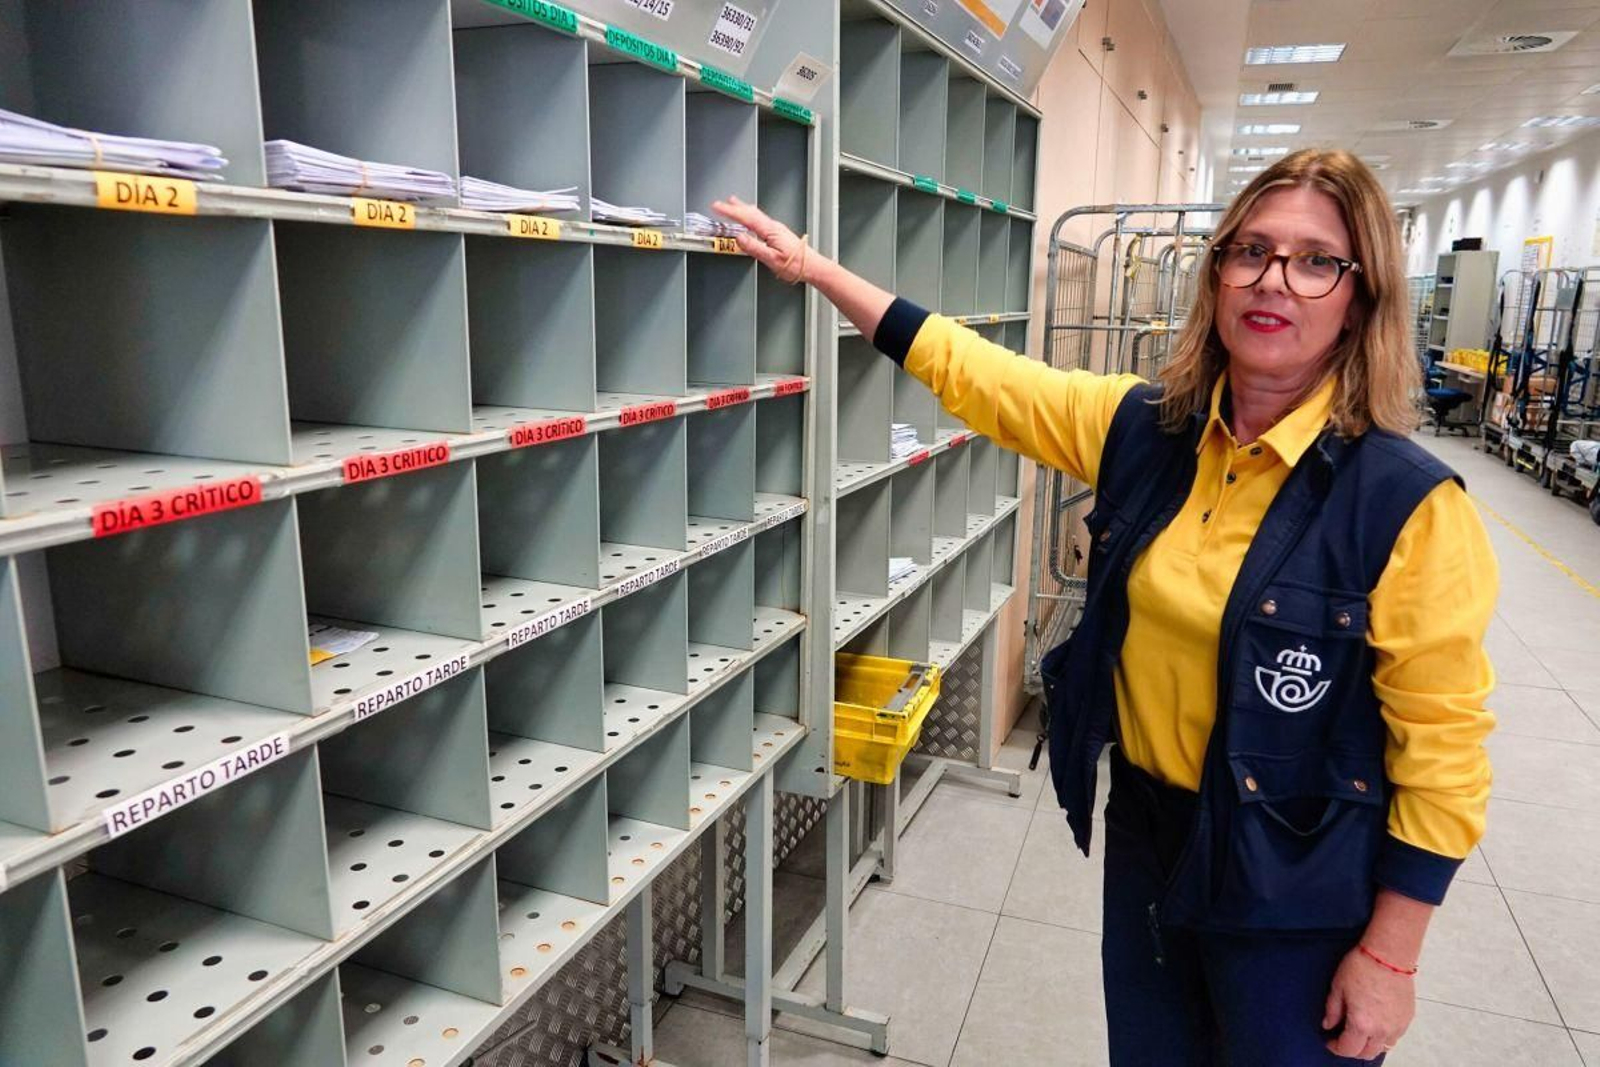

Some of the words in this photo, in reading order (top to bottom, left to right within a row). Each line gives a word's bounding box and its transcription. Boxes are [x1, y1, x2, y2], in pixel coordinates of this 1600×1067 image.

[721, 6, 755, 31] 36330/31
[711, 30, 745, 54] 36390/92
[166, 186, 179, 208] 2
[398, 205, 407, 223] 2
[542, 221, 548, 236] 2
[652, 233, 658, 246] 2
[639, 409, 644, 421] 3
[536, 427, 543, 441] 3
[348, 456, 377, 480] DÍA
[380, 457, 389, 473] 3
[102, 501, 144, 531] DÍA
[151, 500, 165, 521] 3
[171, 481, 254, 516] CRÍTICO
[702, 537, 730, 556] REPARTO
[730, 527, 748, 544] TARDE
[620, 571, 654, 596] REPARTO
[656, 559, 678, 579] TARDE
[511, 615, 557, 647] REPARTO
[559, 600, 589, 624] TARDE
[357, 676, 423, 718] REPARTO
[426, 655, 468, 687] TARDE
[112, 770, 216, 832] REPARTO
[219, 737, 284, 780] TARDE
